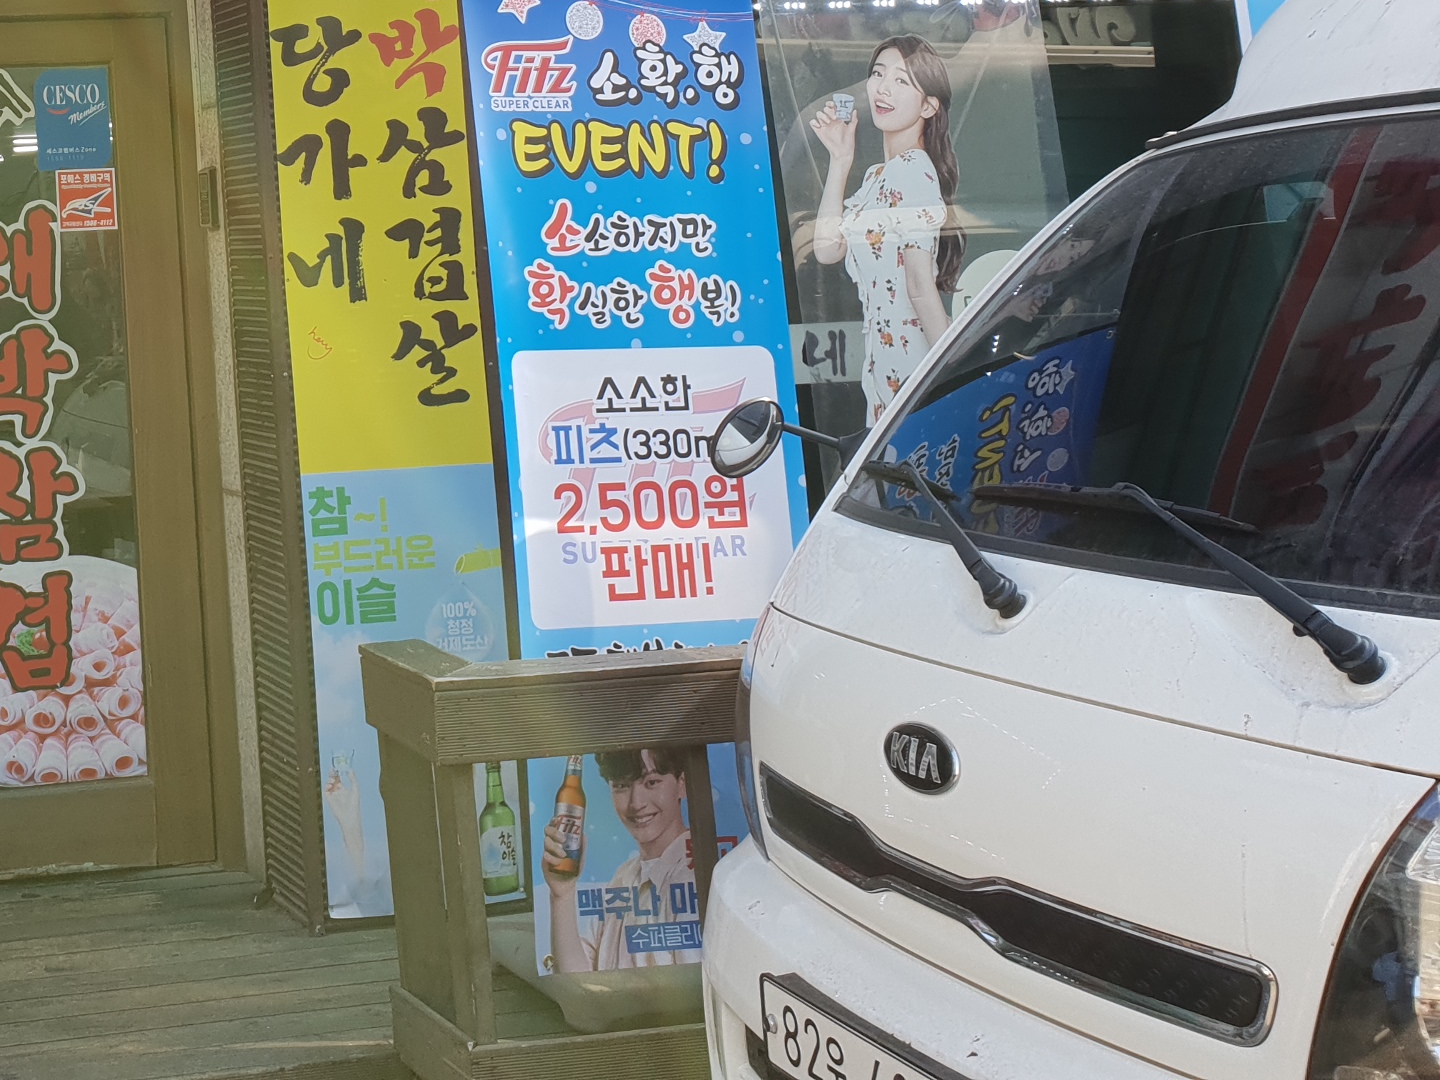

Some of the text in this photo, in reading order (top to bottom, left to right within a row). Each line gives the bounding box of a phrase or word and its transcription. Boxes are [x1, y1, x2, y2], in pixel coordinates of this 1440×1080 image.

[484, 36, 578, 98] Fitz
[42, 81, 101, 107] CESCO
[67, 100, 108, 126] Members
[491, 96, 572, 111] SUPER CLEAR
[268, 15, 369, 304] 당가네
[509, 117, 728, 184] EVENT!
[83, 173, 111, 184] 경비구역
[541, 199, 716, 257] 소소하지만
[525, 260, 741, 329] 확실한 행복!
[801, 328, 848, 378] 네
[595, 373, 692, 414] 소소한
[550, 422, 714, 466] 피츠(330m
[553, 474, 749, 536] 2,500원
[312, 533, 436, 577] 부드러운
[599, 542, 715, 603] 판매!
[316, 577, 398, 626] 이슬
[441, 600, 477, 618] 100%
[890, 731, 942, 785] KIA
[497, 831, 513, 850] 참
[501, 847, 518, 867] 이슬
[576, 884, 661, 922] 맥주나
